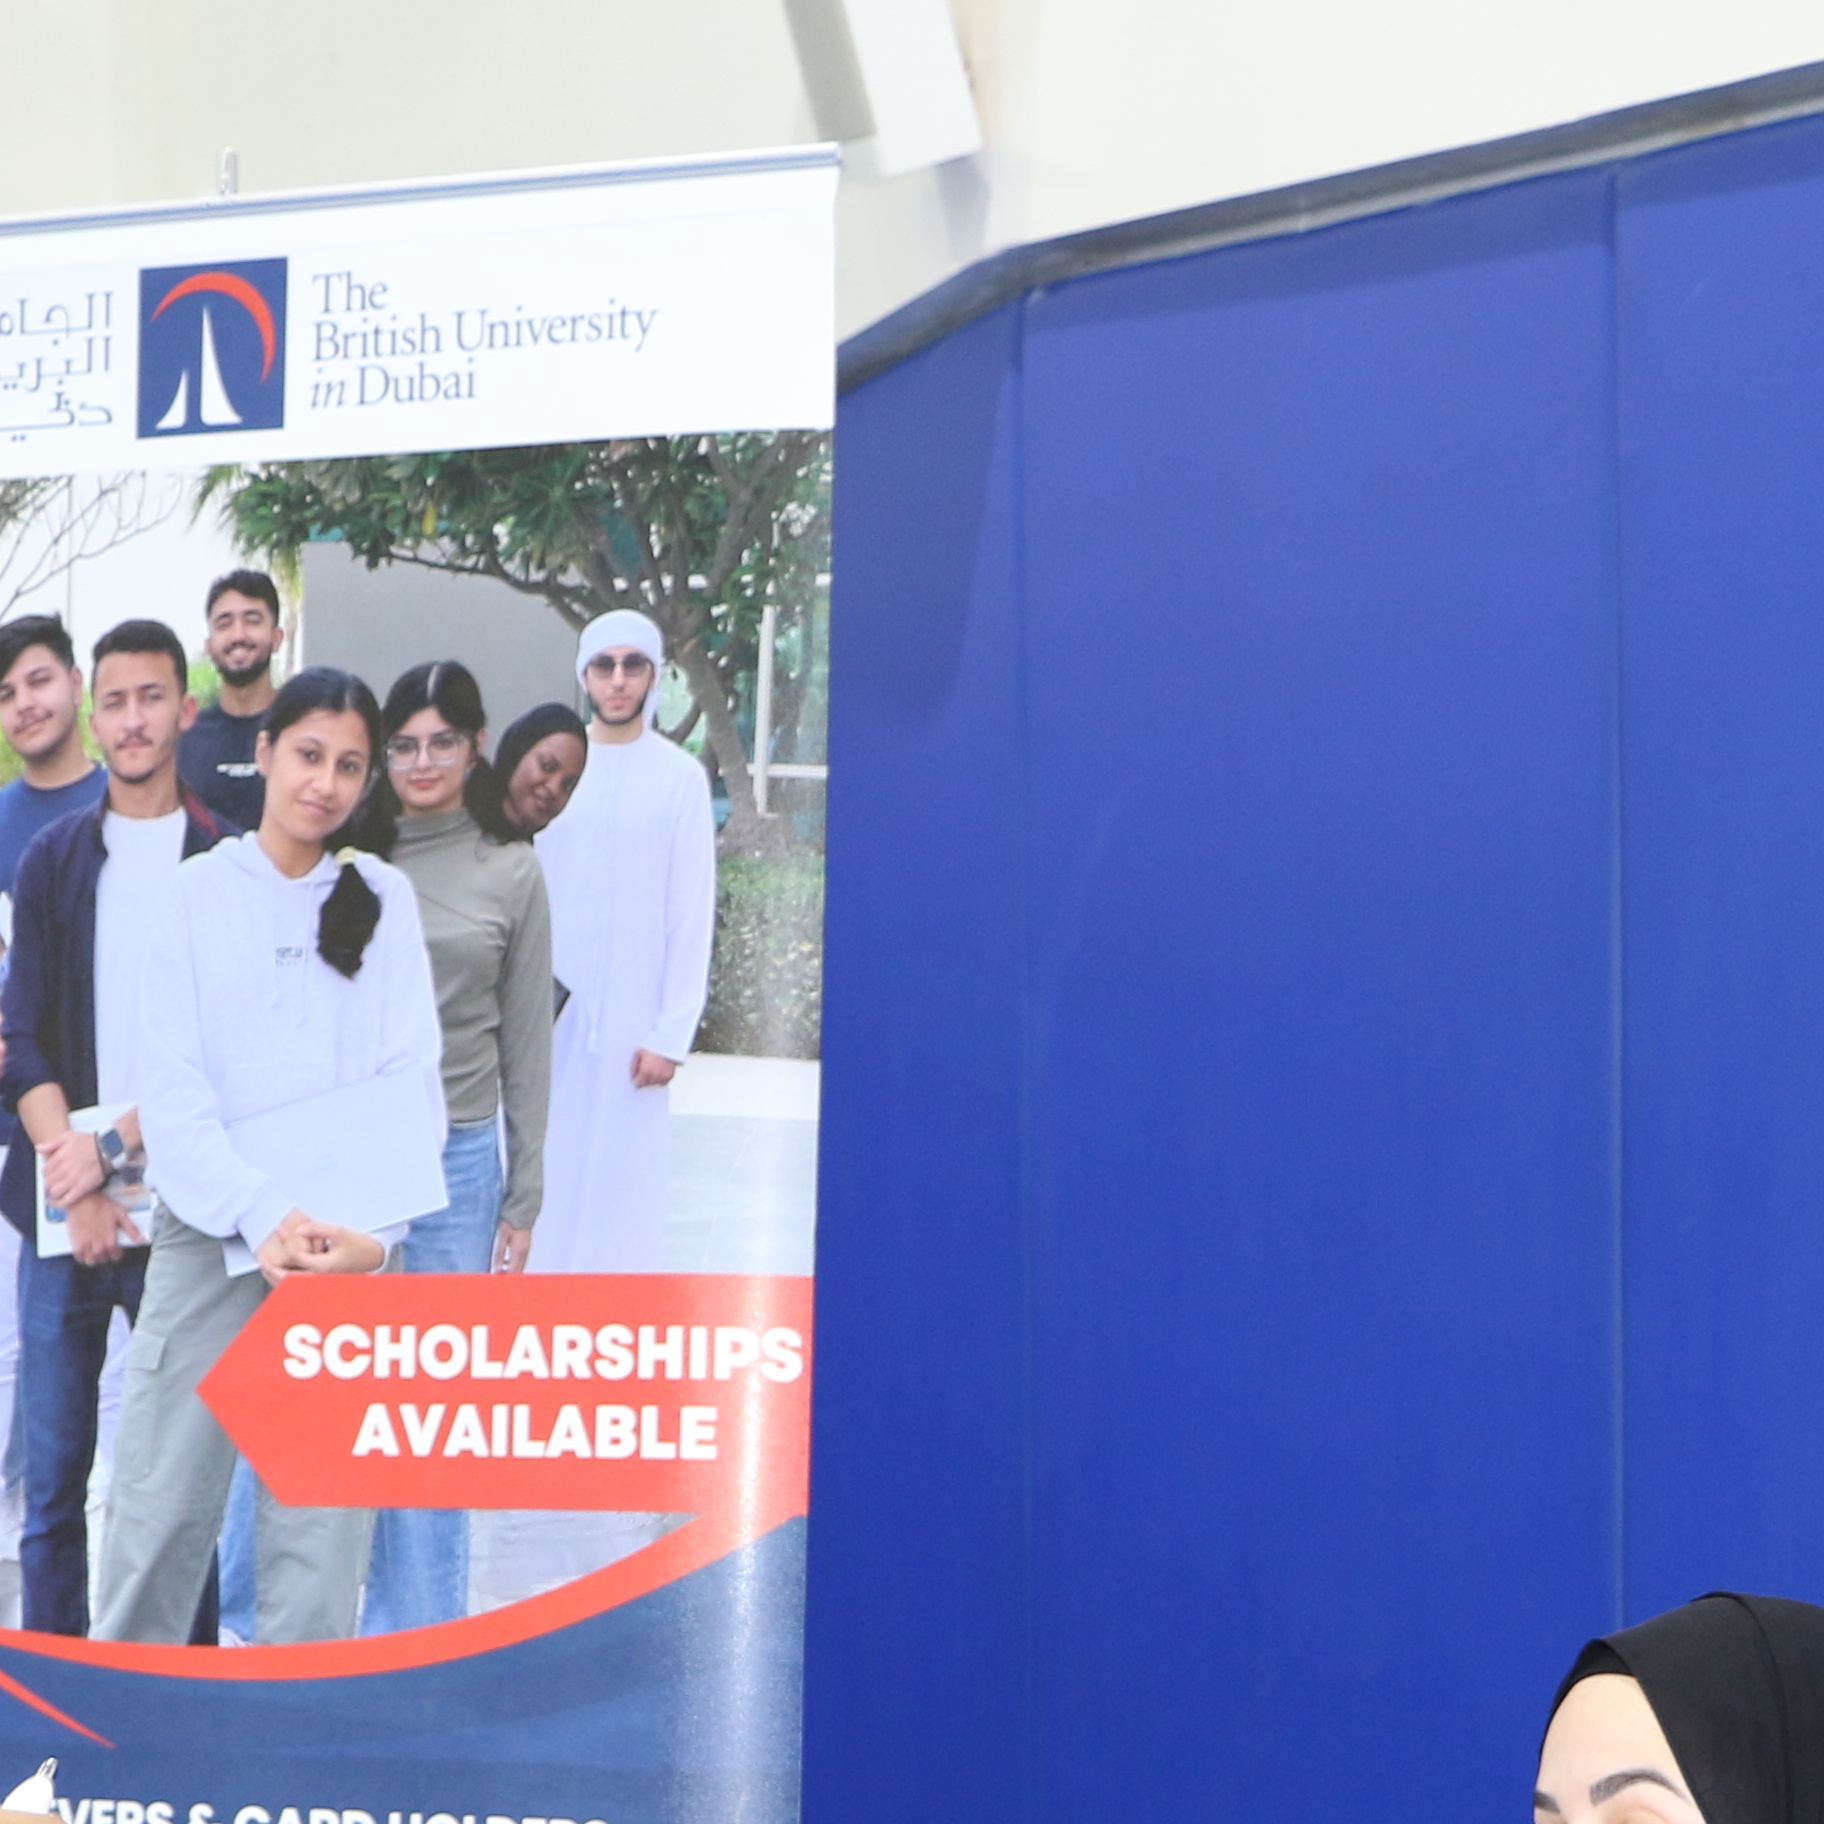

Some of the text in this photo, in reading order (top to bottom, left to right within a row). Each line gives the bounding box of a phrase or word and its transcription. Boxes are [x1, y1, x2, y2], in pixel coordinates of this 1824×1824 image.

[312, 271, 388, 314] The
[313, 298, 658, 361] British University
[310, 357, 476, 409] in Dubai
[282, 1323, 804, 1383] SCHOLARSHIPS
[352, 1404, 719, 1461] AVAILABLE
